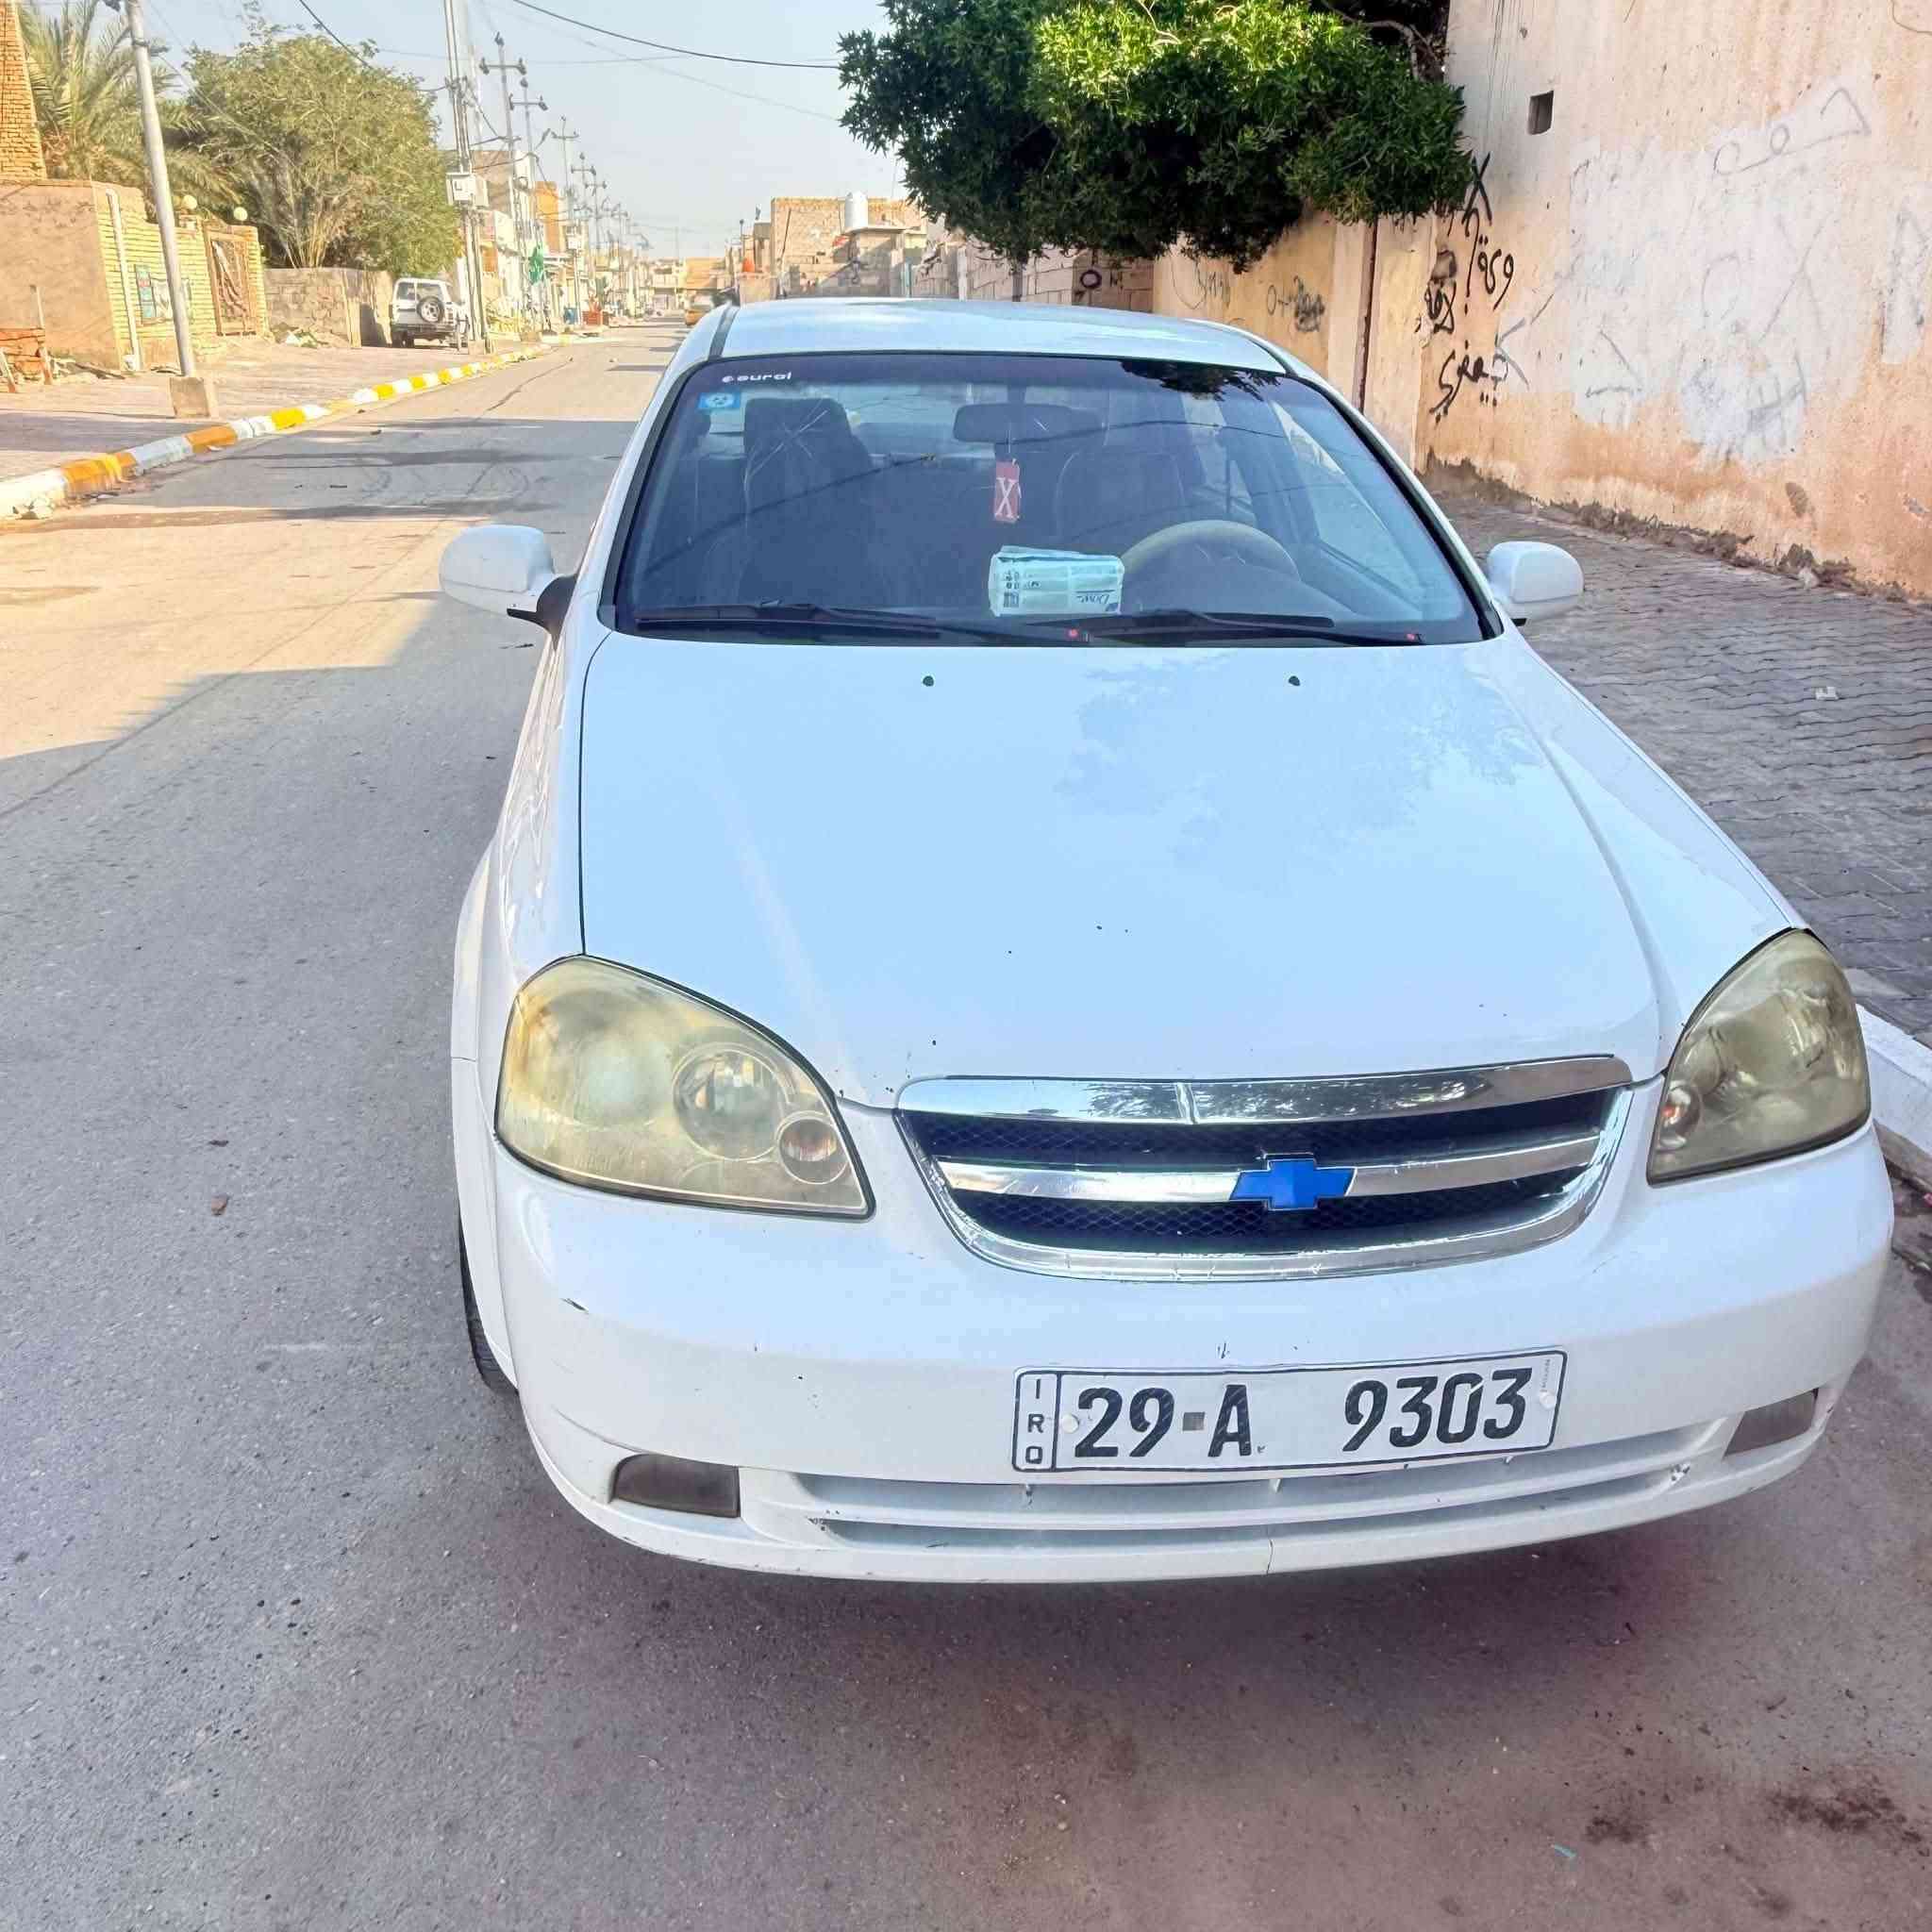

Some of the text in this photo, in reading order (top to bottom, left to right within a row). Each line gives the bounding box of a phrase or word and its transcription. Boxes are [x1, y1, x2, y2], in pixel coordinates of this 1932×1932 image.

[1074, 1387, 1174, 1458] 29
[1208, 1384, 1252, 1457] A
[1341, 1367, 1533, 1452] 9303
